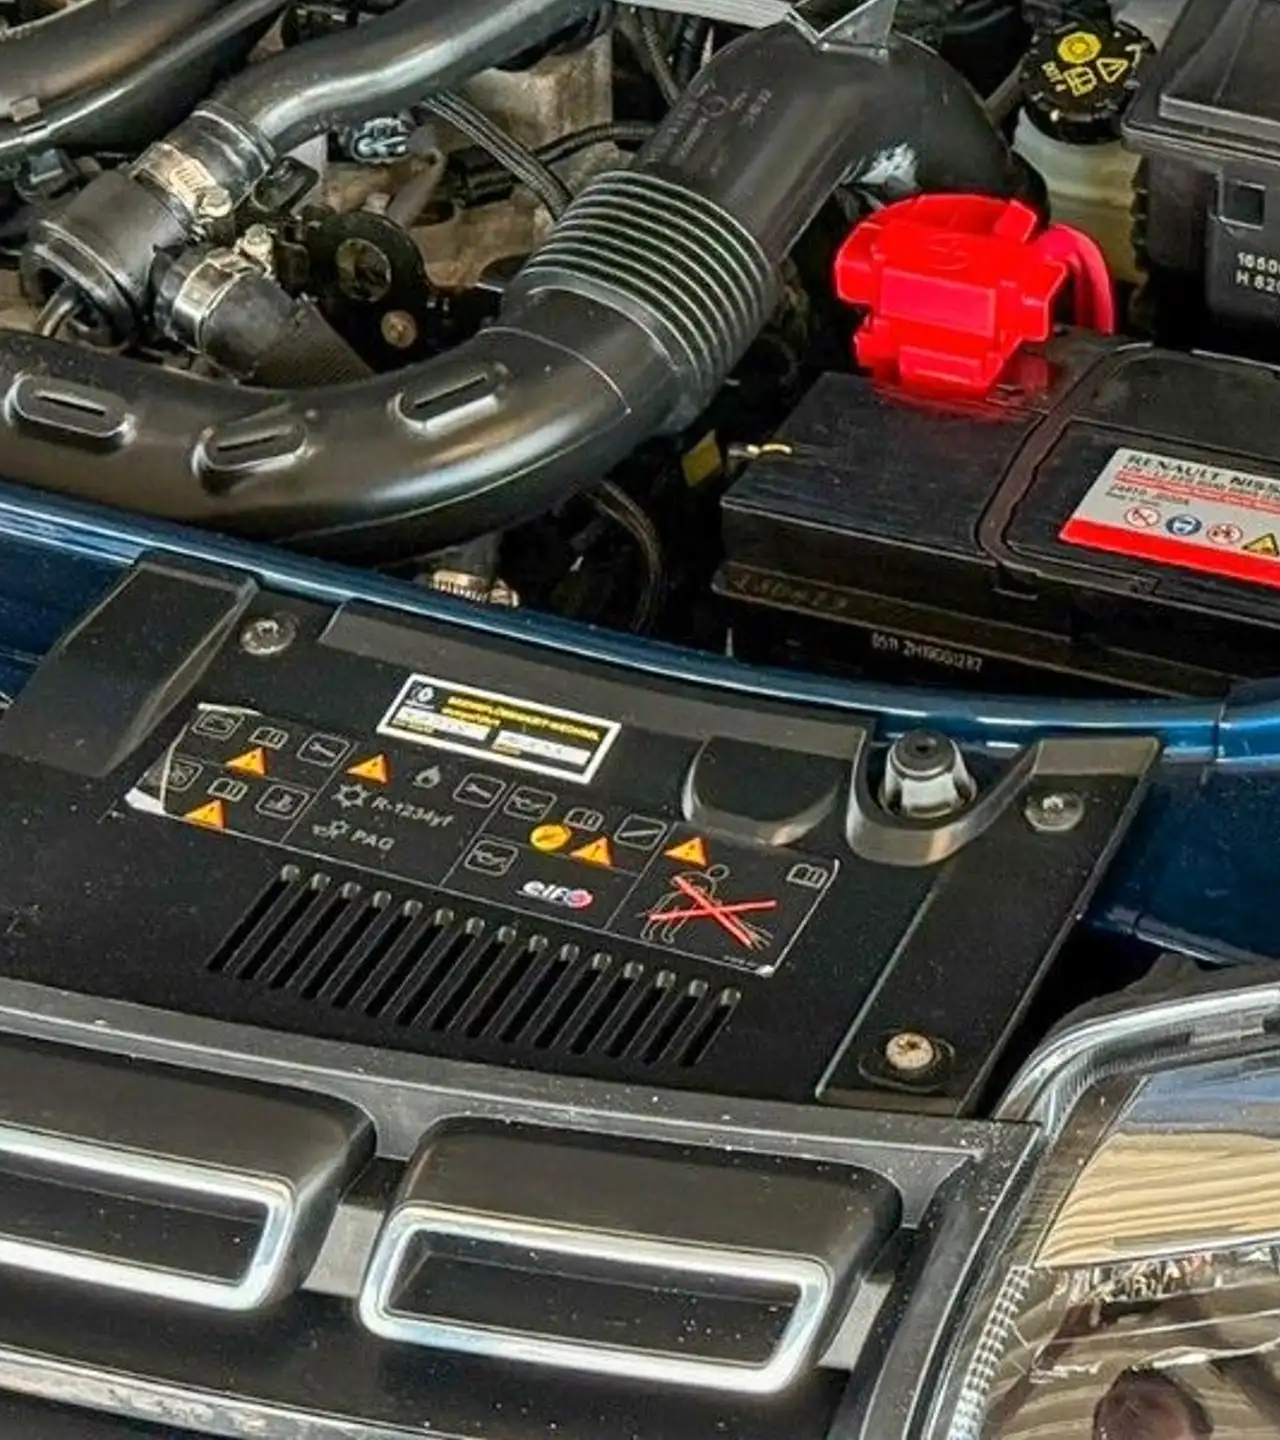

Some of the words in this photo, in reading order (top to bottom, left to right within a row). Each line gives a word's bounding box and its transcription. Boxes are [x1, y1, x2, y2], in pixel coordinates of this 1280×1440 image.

[1126, 453, 1222, 482] RENAULT
[370, 796, 455, 827] R-1234yf
[349, 828, 396, 851] PAG
